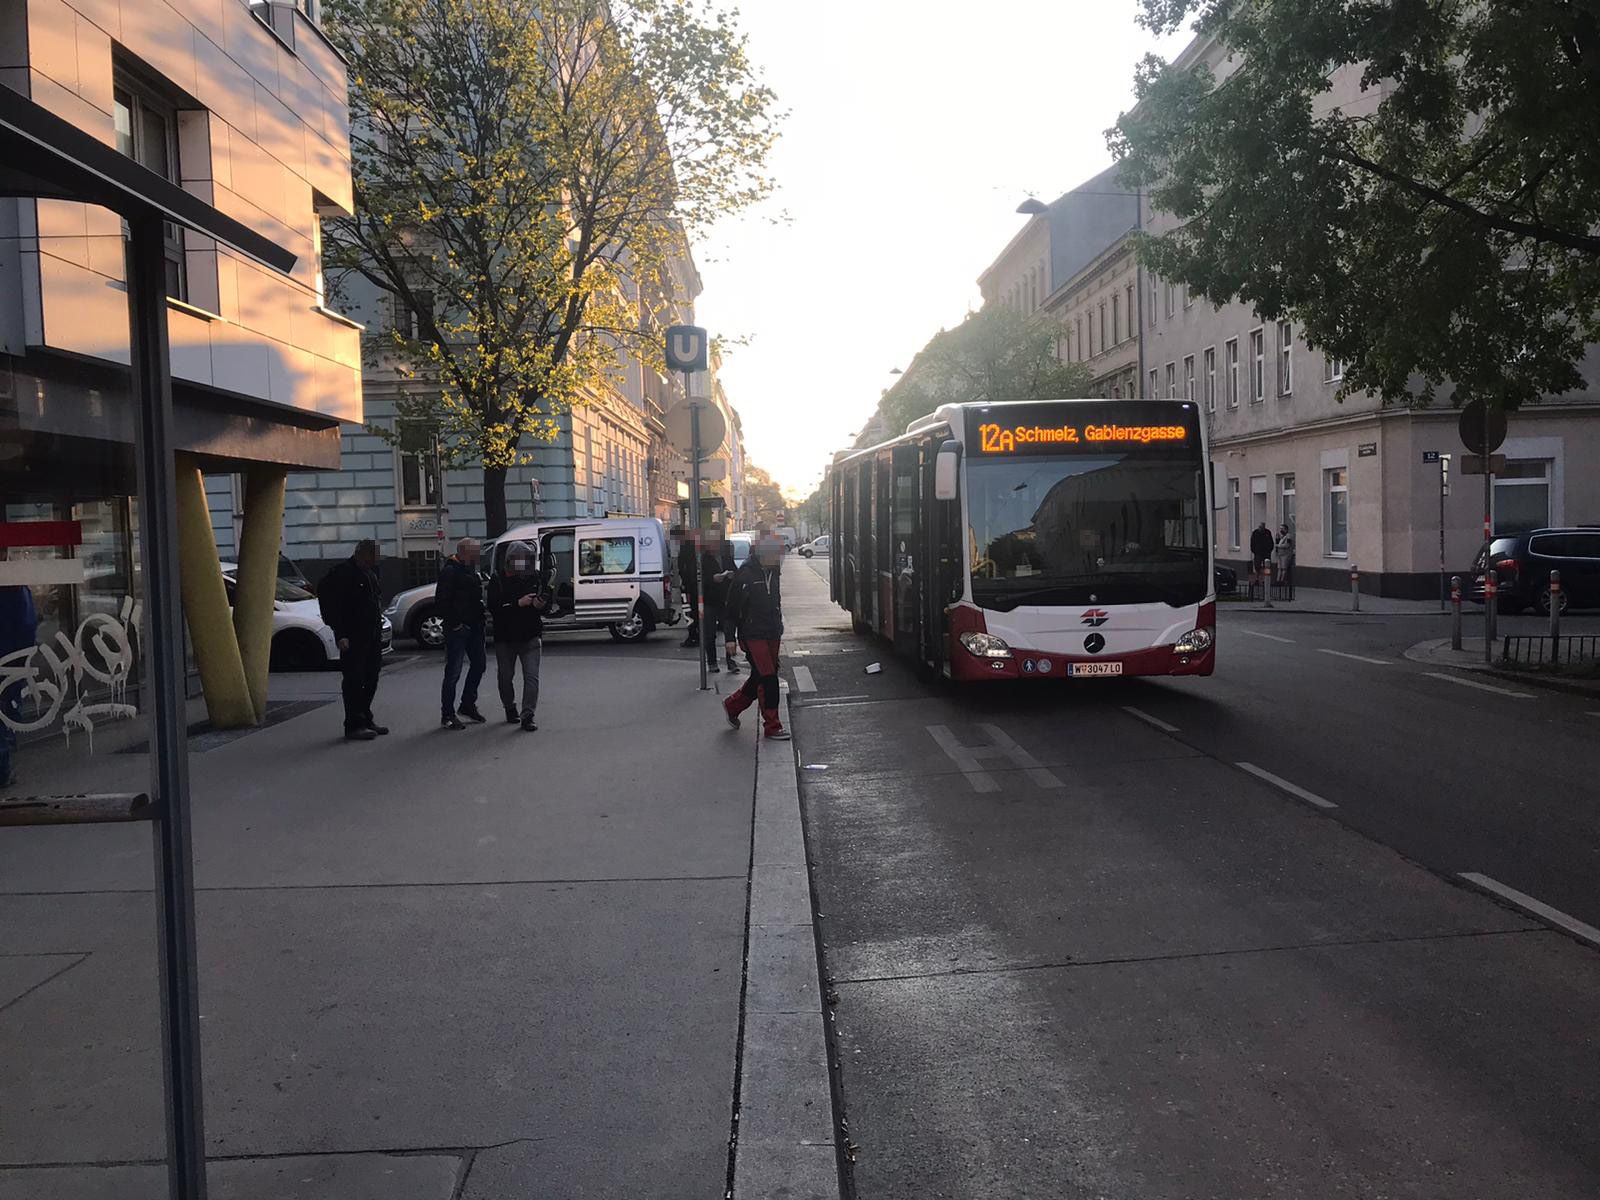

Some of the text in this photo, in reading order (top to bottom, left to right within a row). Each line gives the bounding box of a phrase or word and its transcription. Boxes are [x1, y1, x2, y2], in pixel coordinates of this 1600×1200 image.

[674, 334, 699, 362] U
[979, 423, 1186, 452] 12A Schmelz, Gablenzgasse
